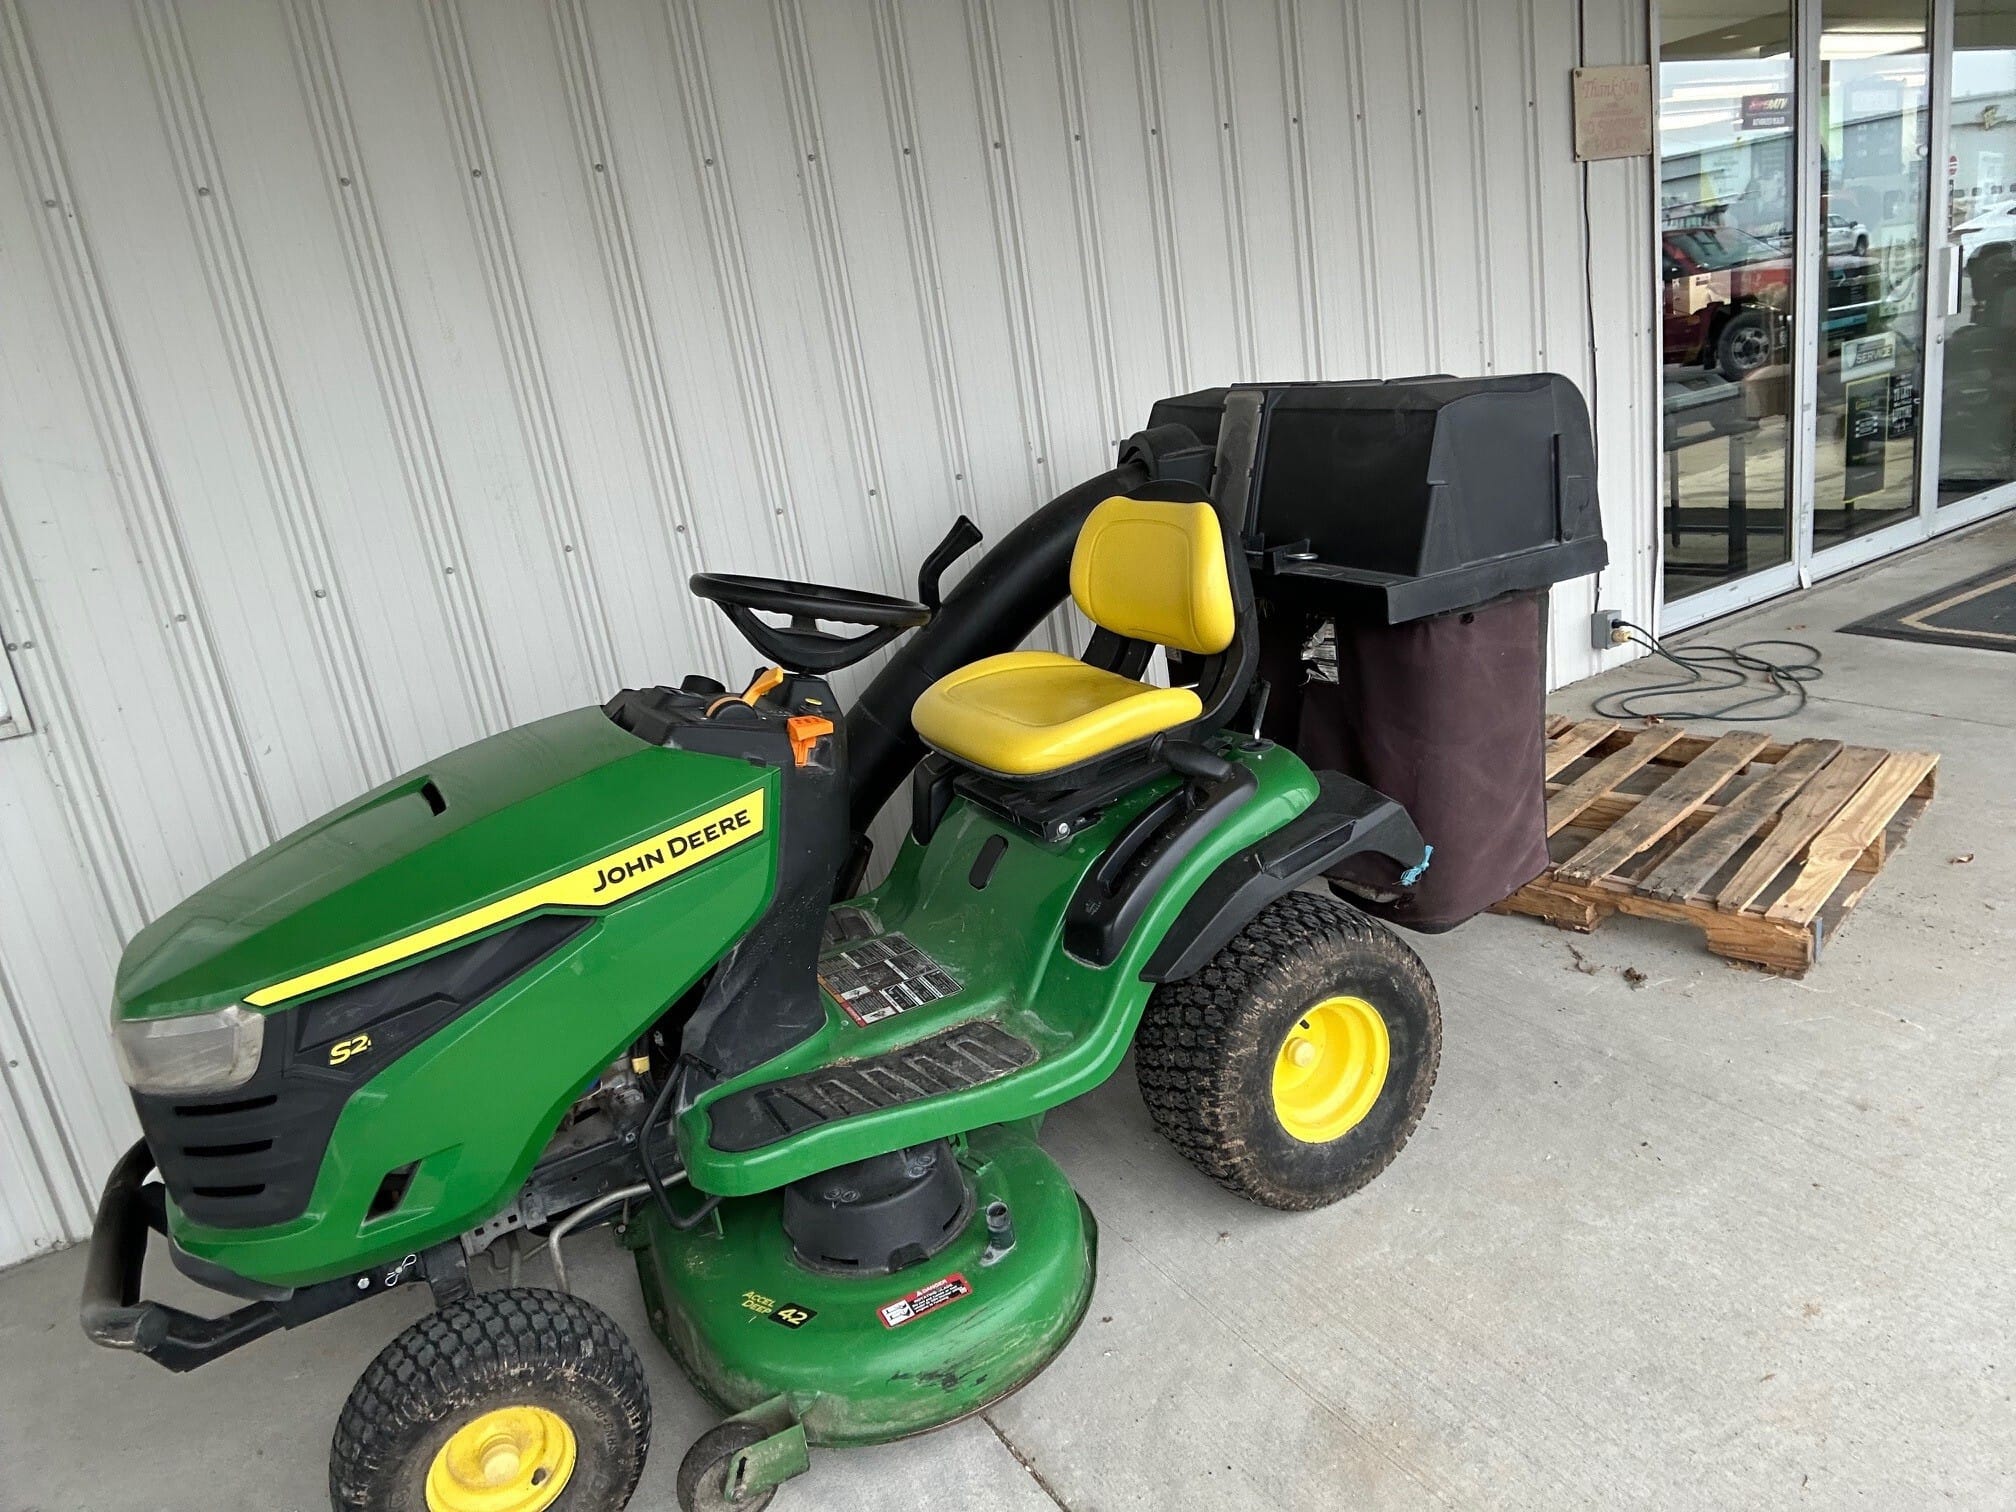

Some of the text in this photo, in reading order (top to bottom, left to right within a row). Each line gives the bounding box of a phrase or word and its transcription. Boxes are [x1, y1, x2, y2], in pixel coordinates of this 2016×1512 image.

[1856, 346, 1893, 364] SERVICE
[593, 809, 752, 893] JOHN DEERE
[741, 1291, 776, 1308] ACCEL
[741, 1300, 773, 1314] DEEP
[777, 1309, 808, 1325] 42
